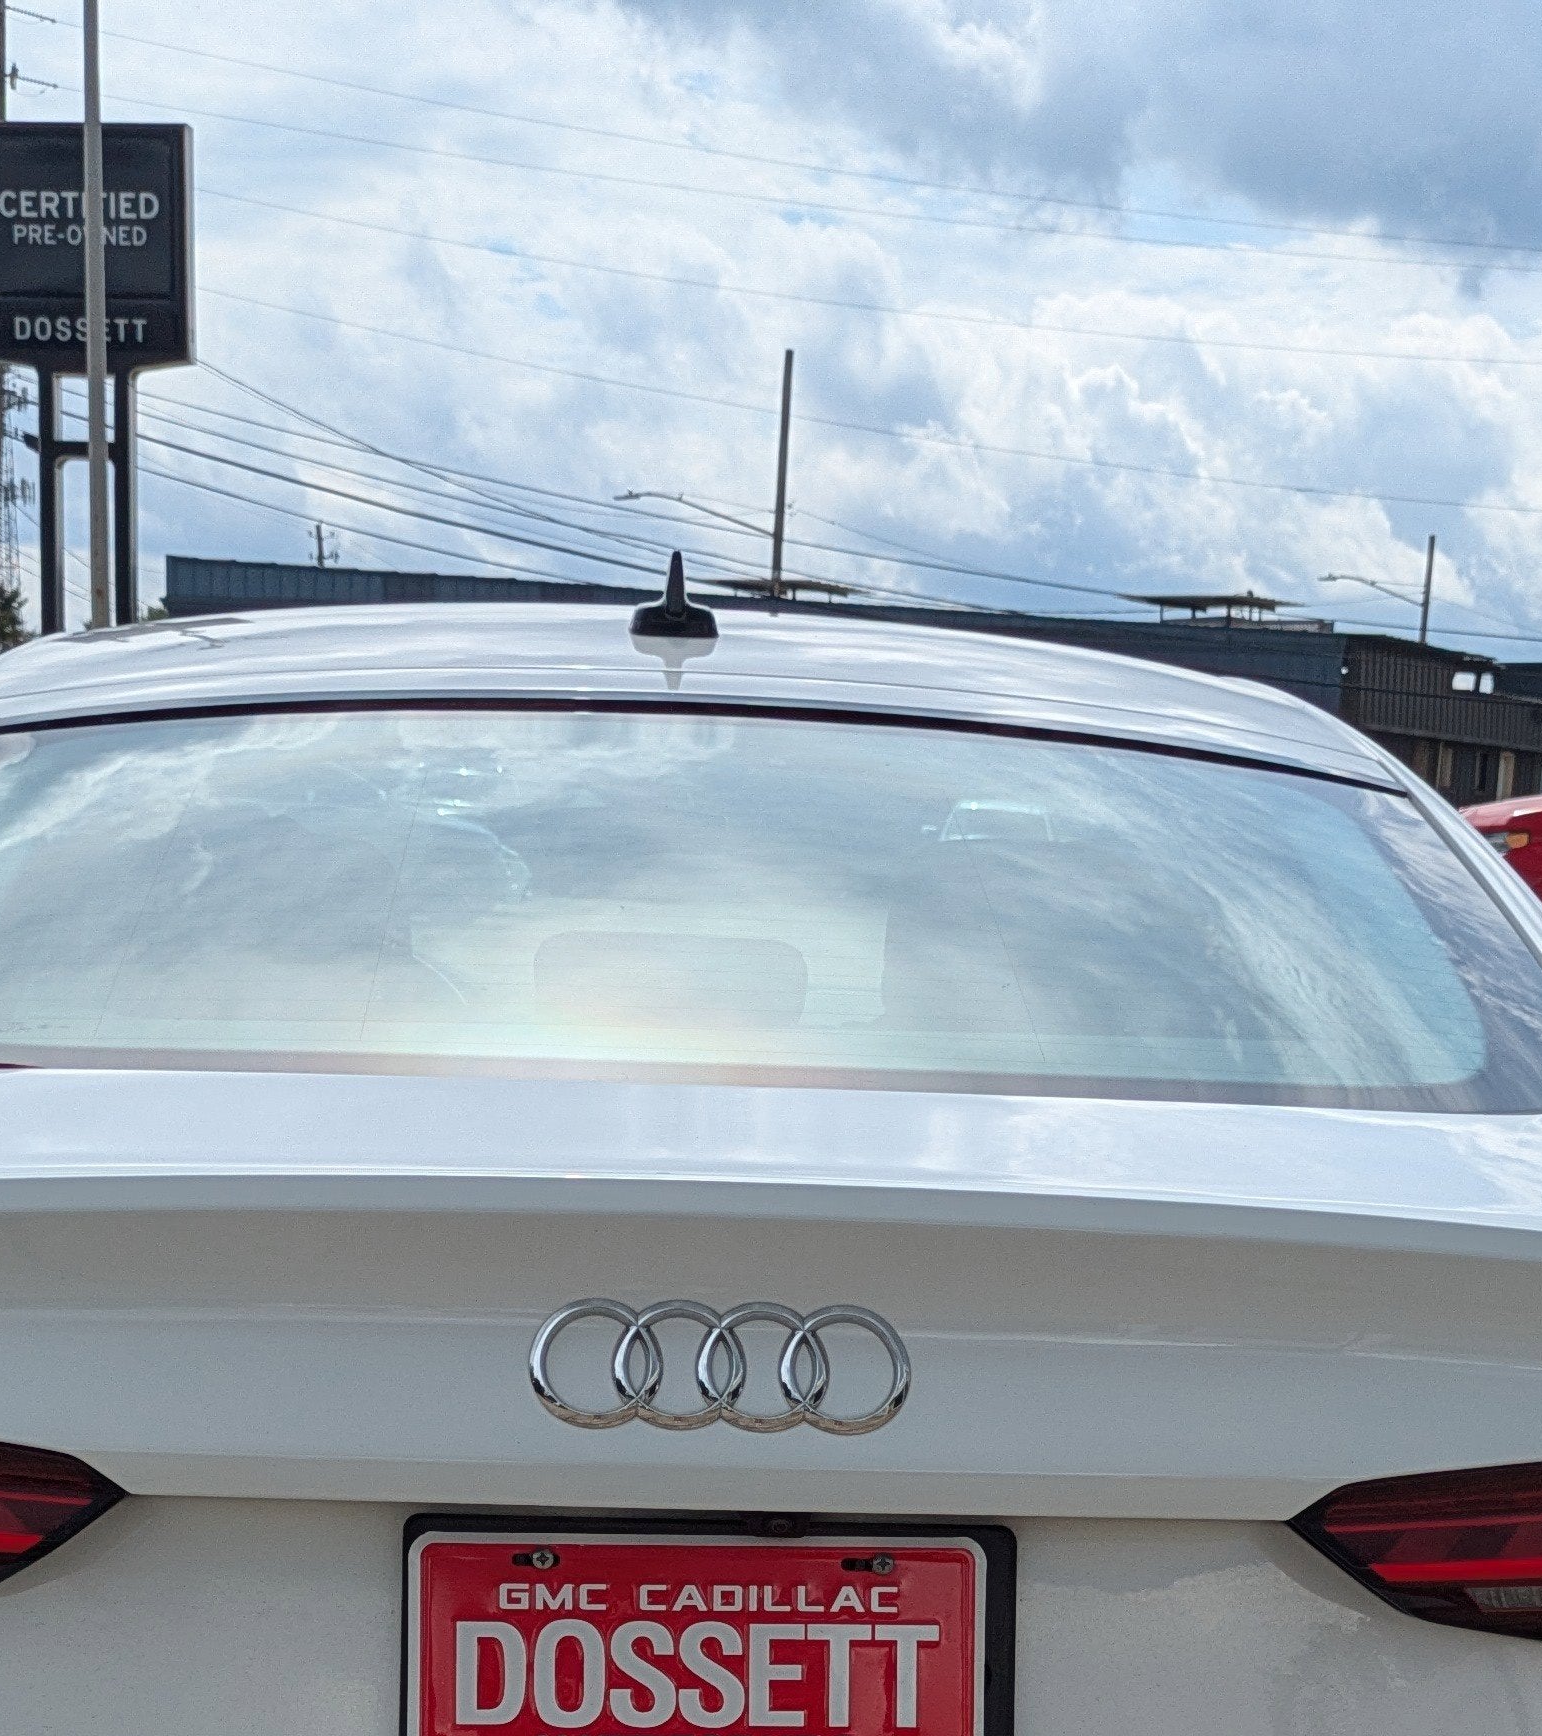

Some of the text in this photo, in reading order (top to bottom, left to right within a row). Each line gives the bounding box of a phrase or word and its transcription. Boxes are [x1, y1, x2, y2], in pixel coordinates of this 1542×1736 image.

[12, 224, 147, 247] PRE-ONED
[499, 1582, 898, 1614] GMC CADILLAC
[455, 1618, 940, 1729] DOSSETT
